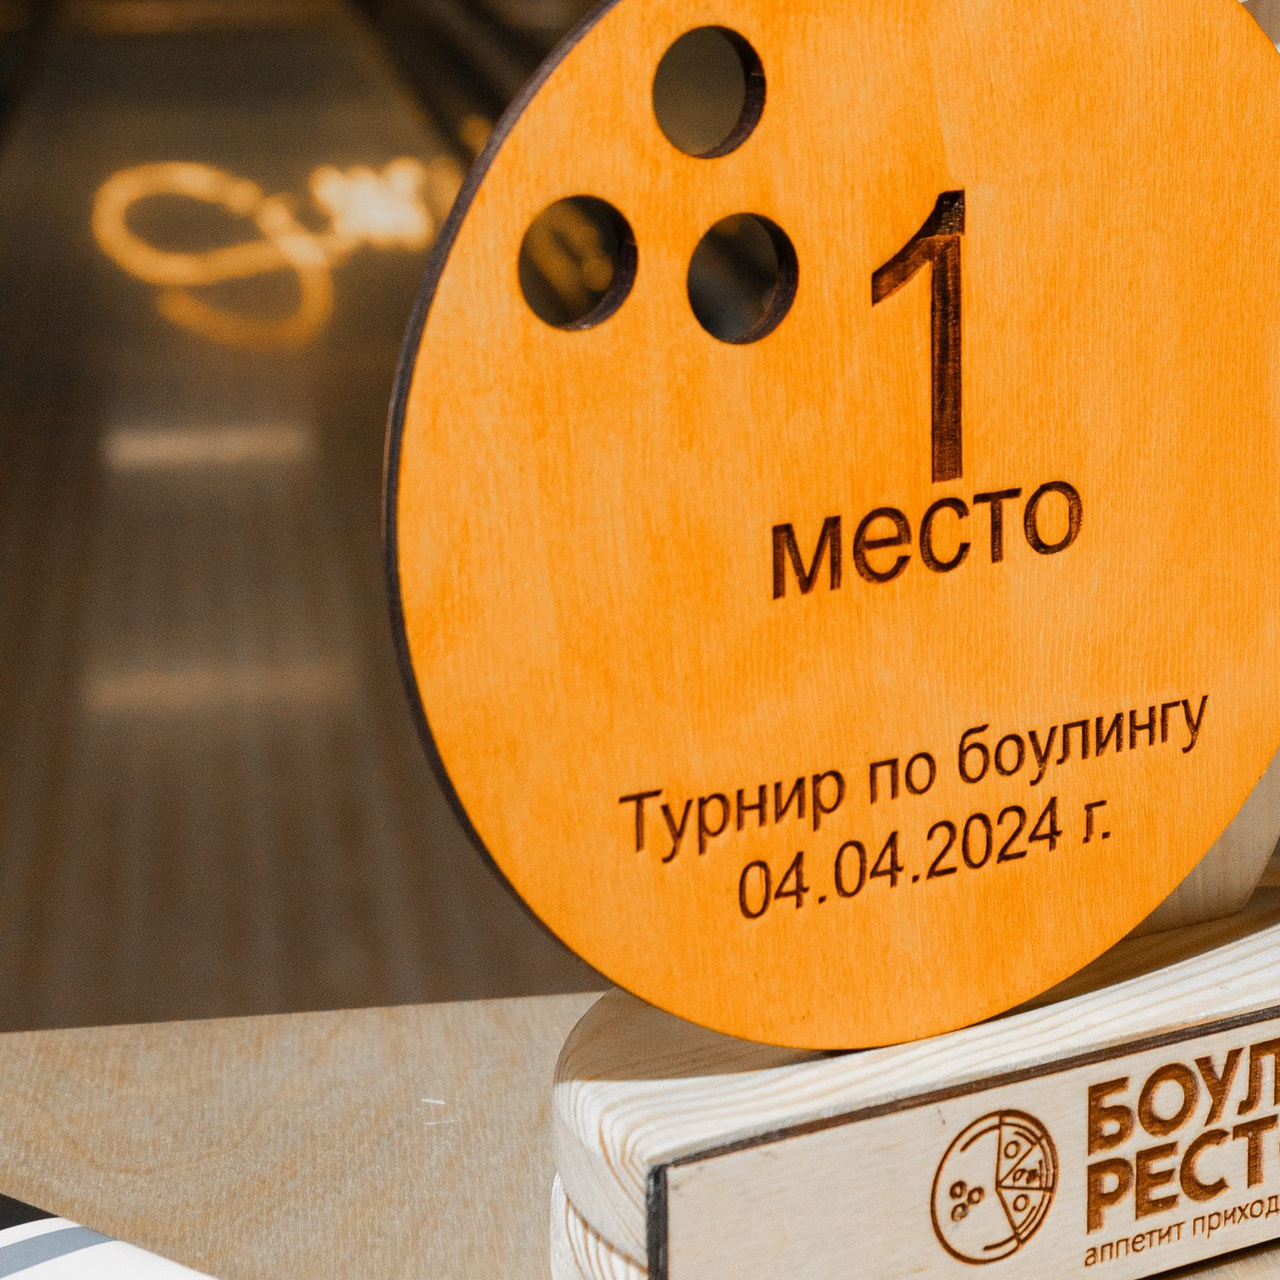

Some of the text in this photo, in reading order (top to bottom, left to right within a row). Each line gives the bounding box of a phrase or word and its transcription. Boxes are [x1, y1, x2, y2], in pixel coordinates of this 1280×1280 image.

[871, 189, 966, 484] 1
[771, 480, 1084, 600] место
[618, 694, 1210, 864] Турнир по боулингу
[738, 796, 1112, 920] 04.04.2024 г.
[1084, 1221, 1186, 1268] аппетит
